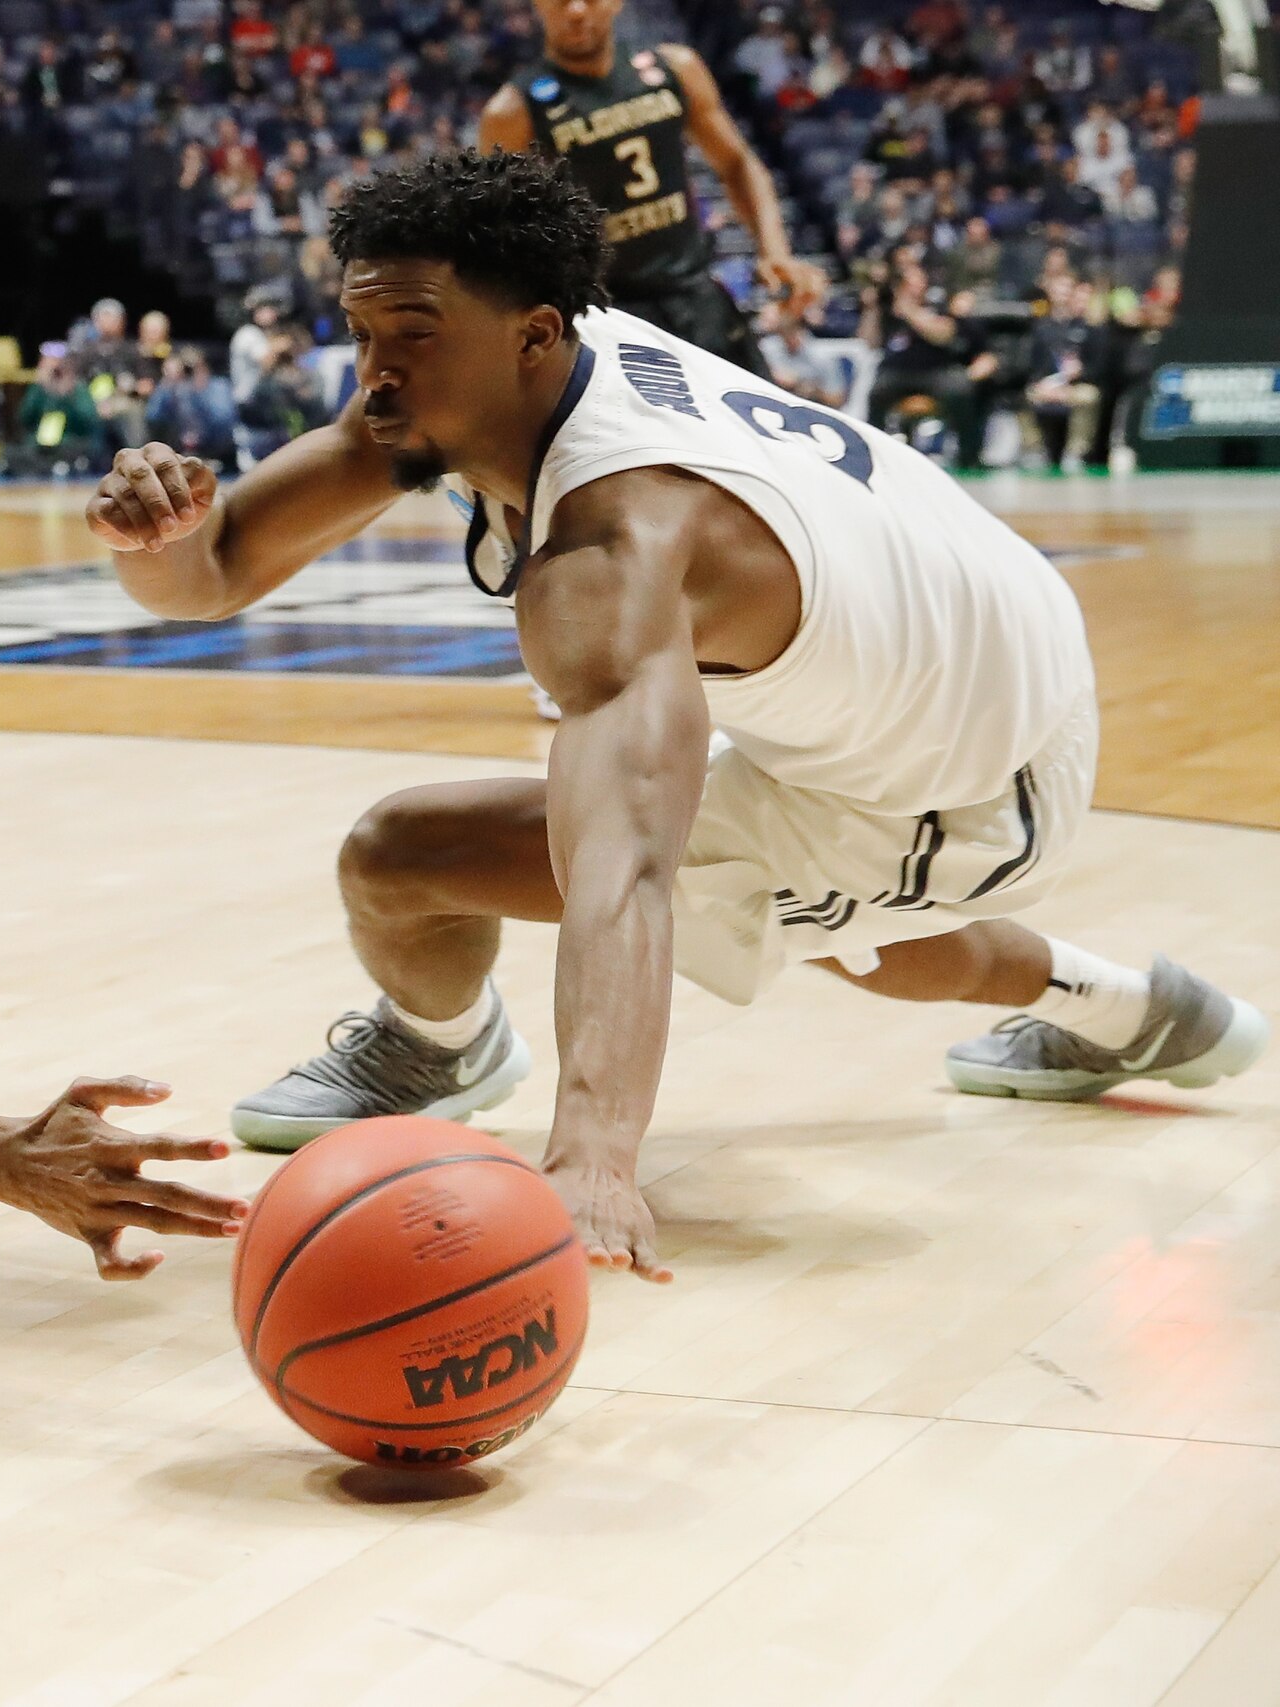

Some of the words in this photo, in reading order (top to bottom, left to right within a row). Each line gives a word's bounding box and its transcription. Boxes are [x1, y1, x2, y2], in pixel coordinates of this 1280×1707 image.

[614, 135, 661, 199] 3
[721, 390, 874, 493] 3
[402, 1304, 558, 1409] NCAA
